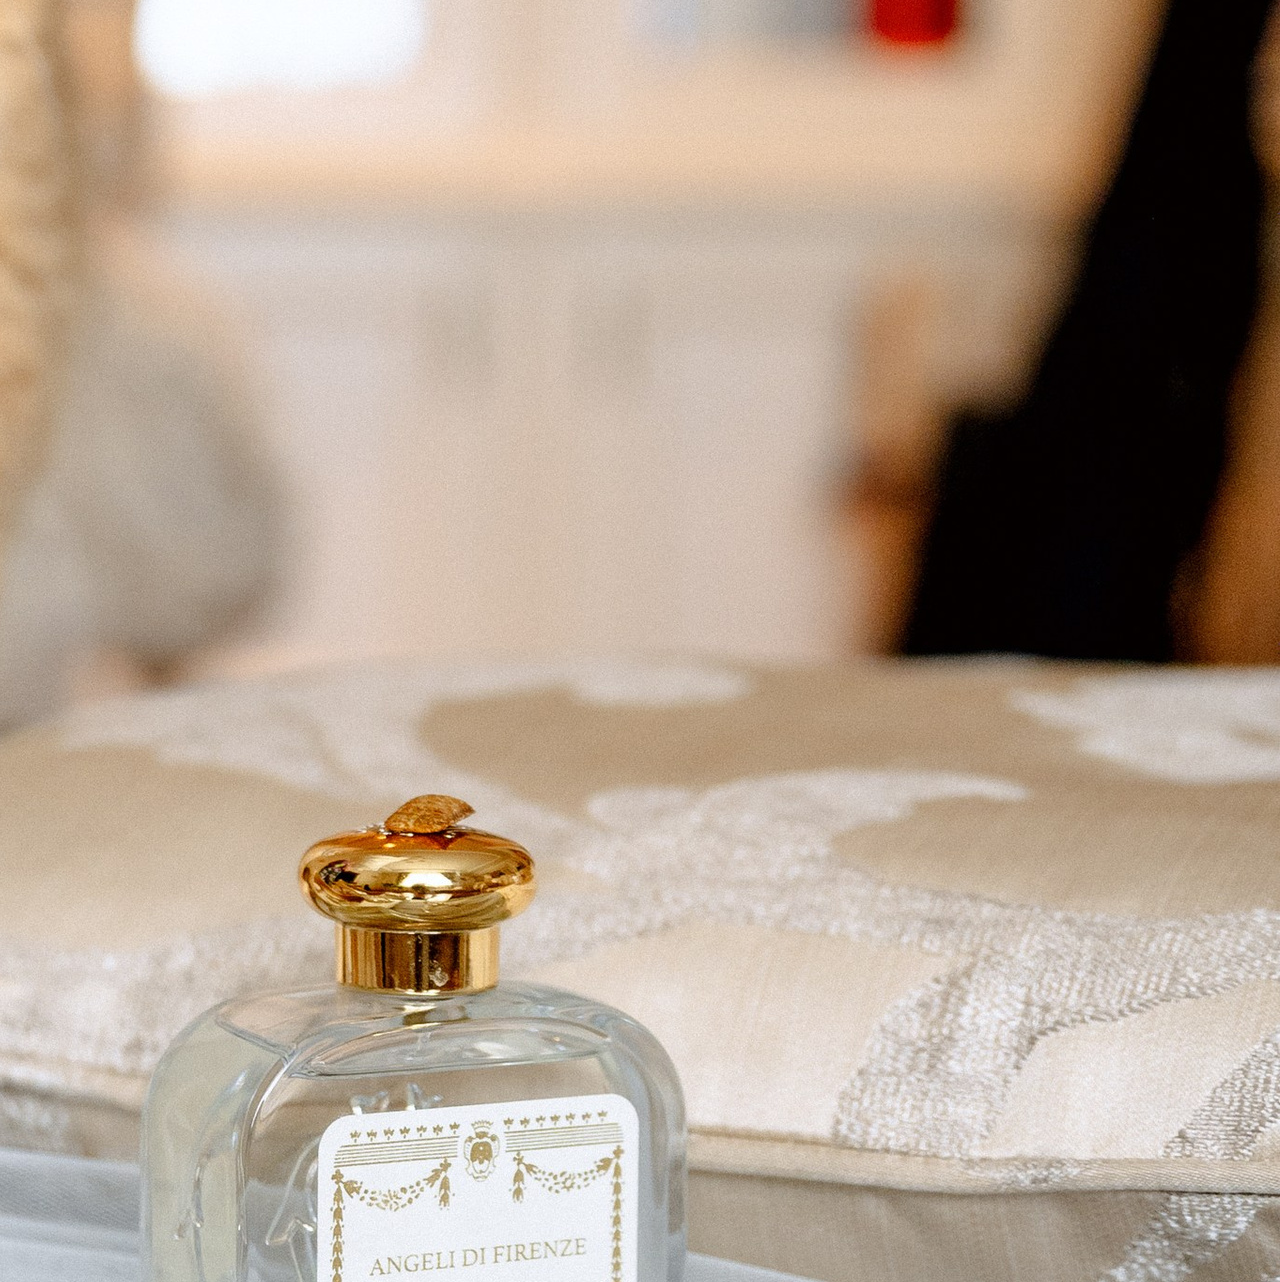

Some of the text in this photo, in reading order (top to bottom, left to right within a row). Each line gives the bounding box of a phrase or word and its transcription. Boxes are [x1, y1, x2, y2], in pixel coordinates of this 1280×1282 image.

[369, 1237, 587, 1276] ANGELI DI FIRENZE
